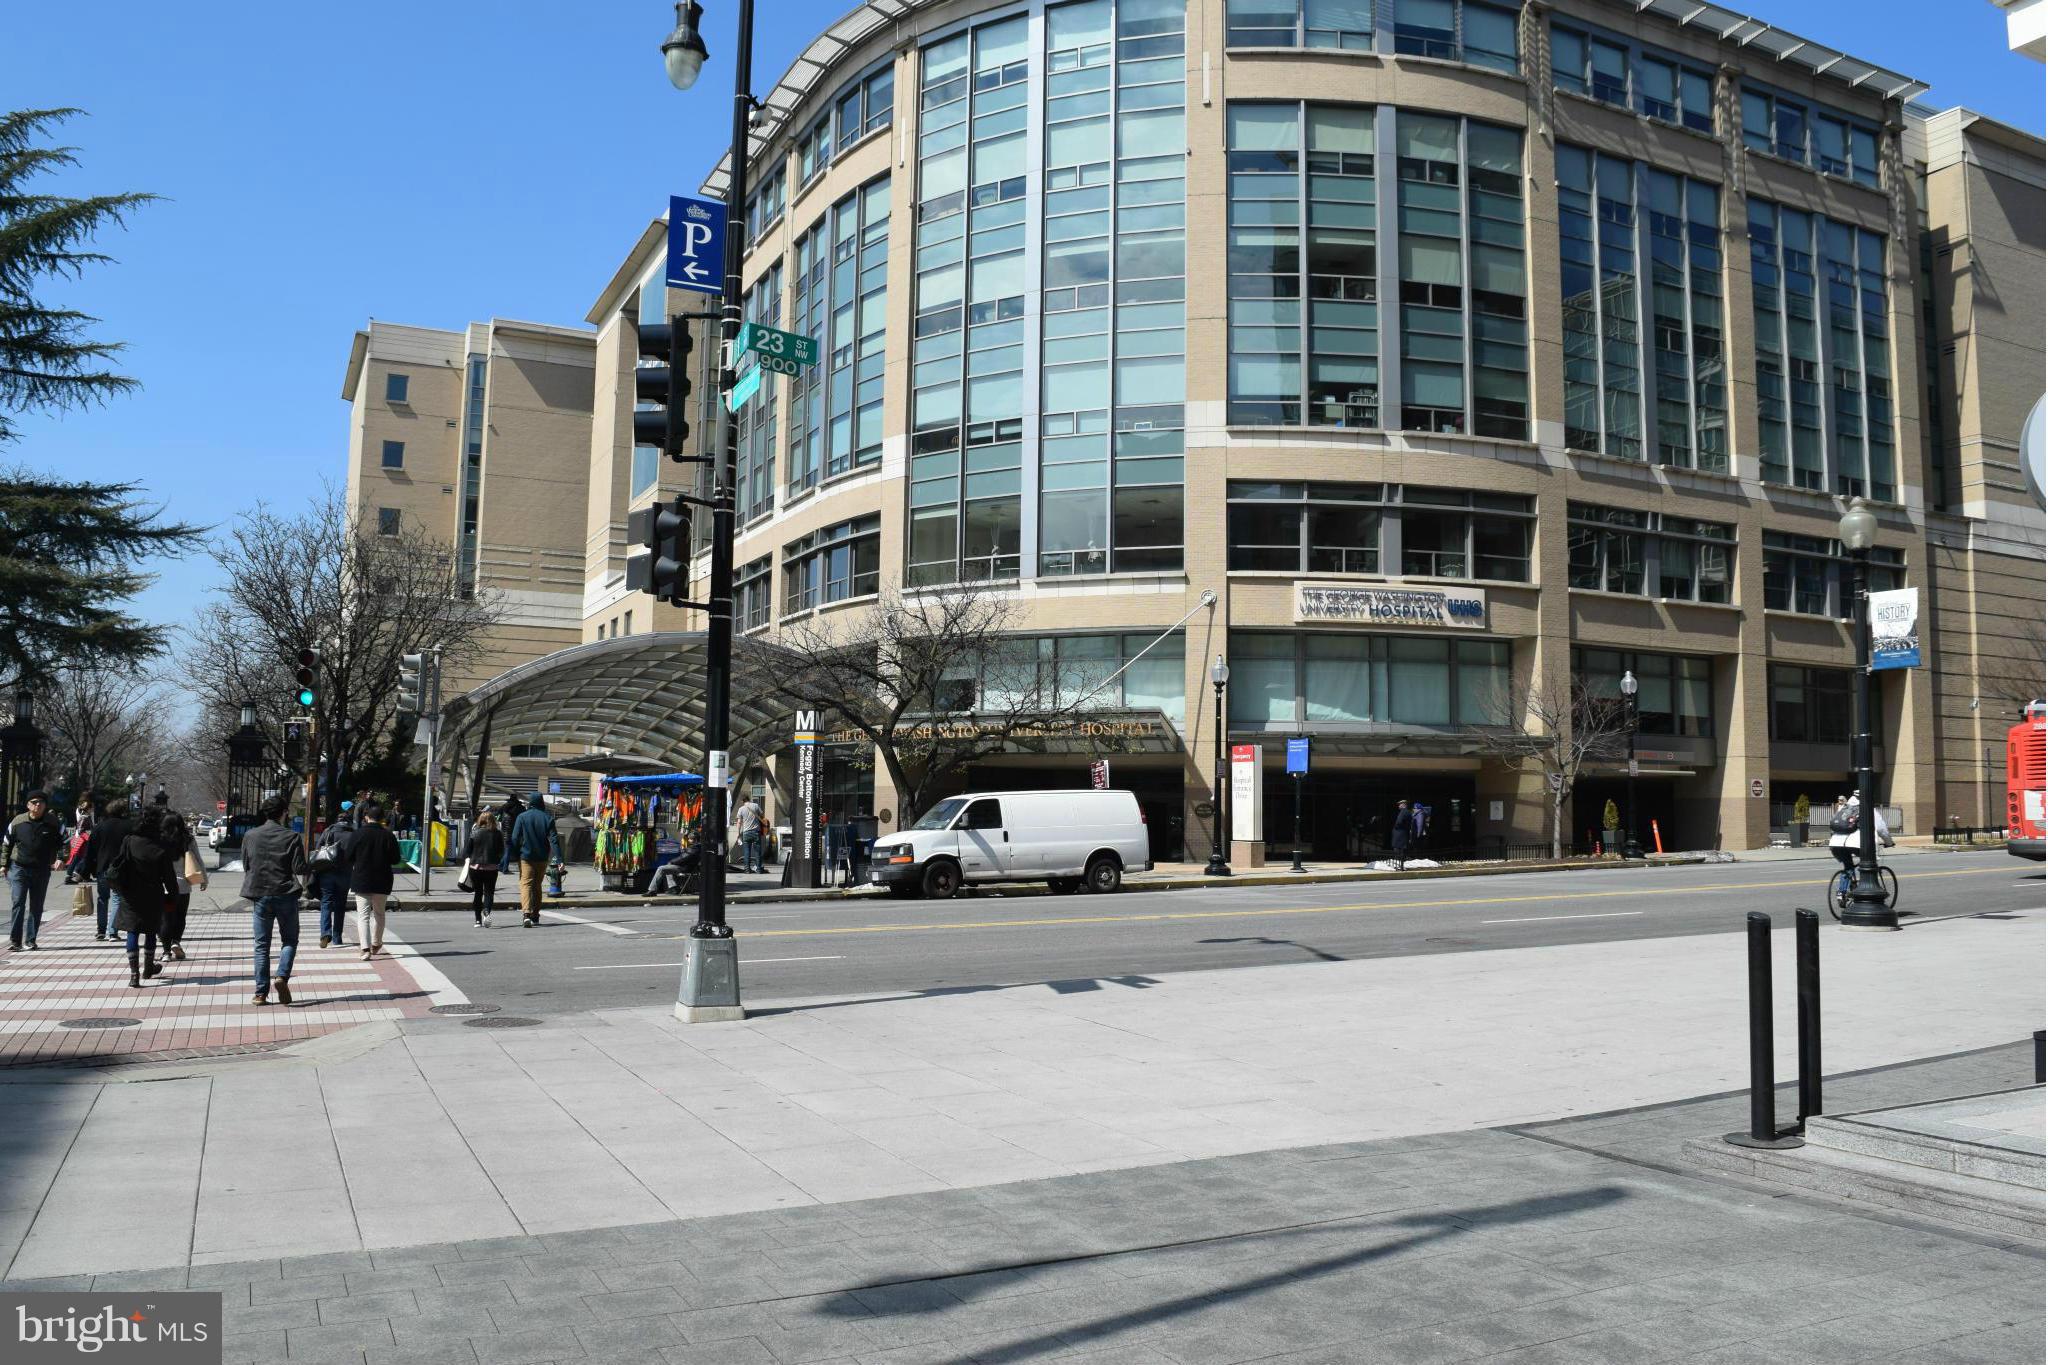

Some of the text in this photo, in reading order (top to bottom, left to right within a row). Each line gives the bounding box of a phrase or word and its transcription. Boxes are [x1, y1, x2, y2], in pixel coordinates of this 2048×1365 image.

[682, 221, 712, 258] P
[756, 329, 784, 354] 23
[795, 339, 808, 350] ST
[760, 354, 798, 374] 900
[794, 349, 808, 360] NW
[1374, 591, 1446, 605] WASHINGTON
[1369, 604, 1444, 620] HOSPITAL
[1877, 604, 1911, 620] HISTORY
[796, 710, 814, 730] M
[1080, 720, 1155, 736] HOSPITAL
[798, 745, 806, 774] Kennedy
[804, 745, 814, 859] Foggy Bottom-GWU Station
